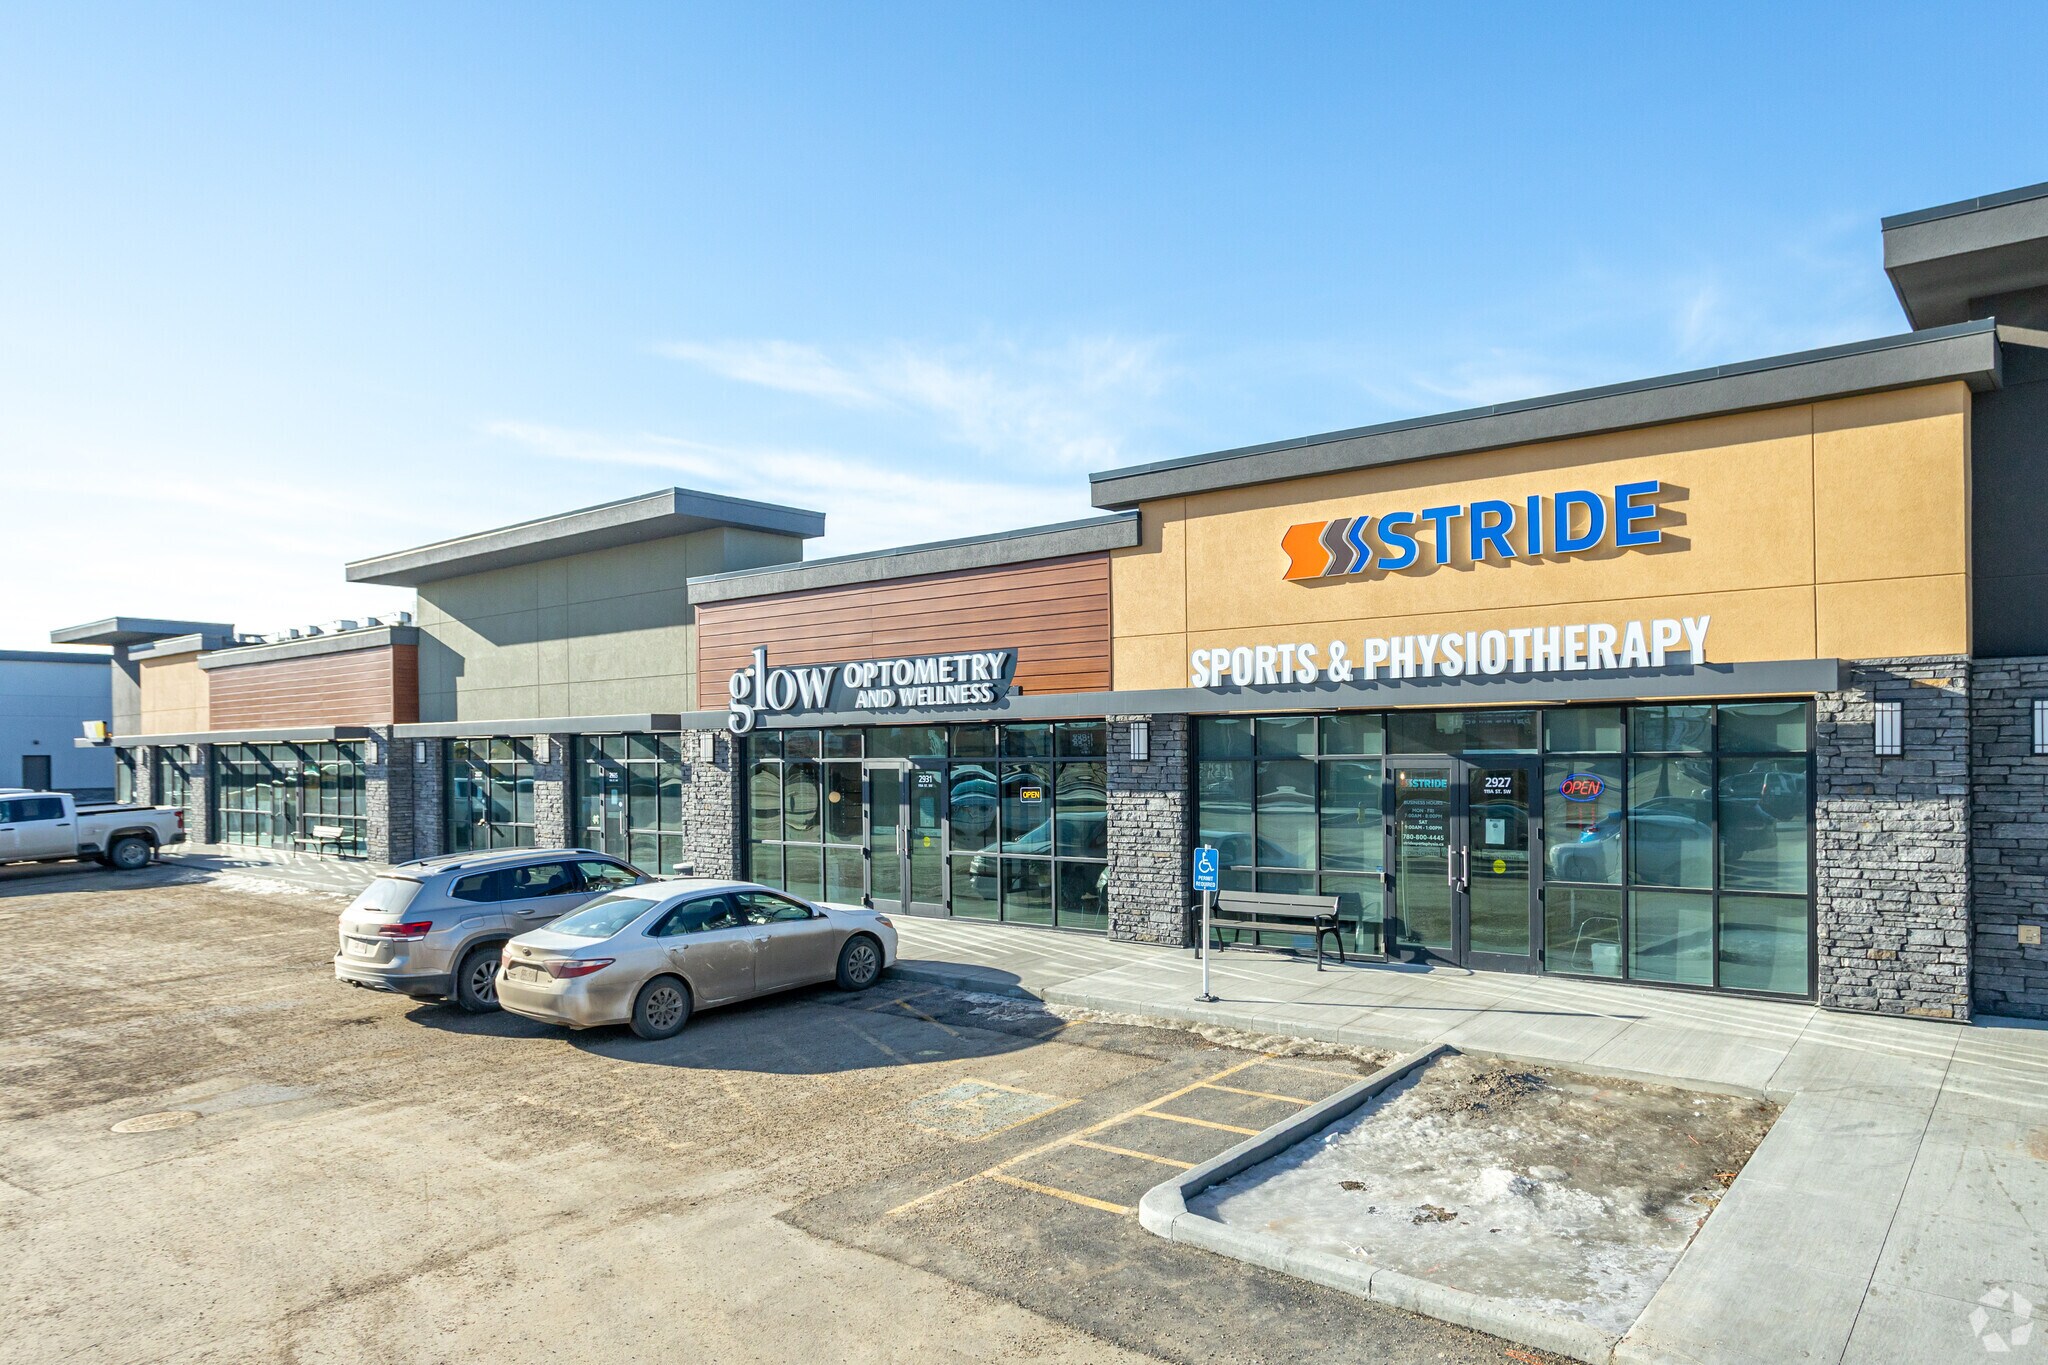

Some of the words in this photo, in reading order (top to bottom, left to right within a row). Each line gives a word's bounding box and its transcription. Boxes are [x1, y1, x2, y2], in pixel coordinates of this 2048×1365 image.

[1376, 479, 1662, 571] STRIDE
[1191, 643, 1319, 688] SPORTS
[1328, 640, 1353, 683] &
[1364, 614, 1711, 681] PHYSIOTHERAPY
[843, 651, 1009, 688] OPTOMETRY
[728, 647, 840, 734] glow
[854, 688, 896, 708] AND
[899, 682, 995, 706] WELLNESS
[918, 775, 933, 783] 2931
[1412, 779, 1447, 788] STRIDE
[1485, 777, 1512, 788] 2927
[1562, 780, 1601, 795] OPEN
[1022, 791, 1040, 799] OPEN
